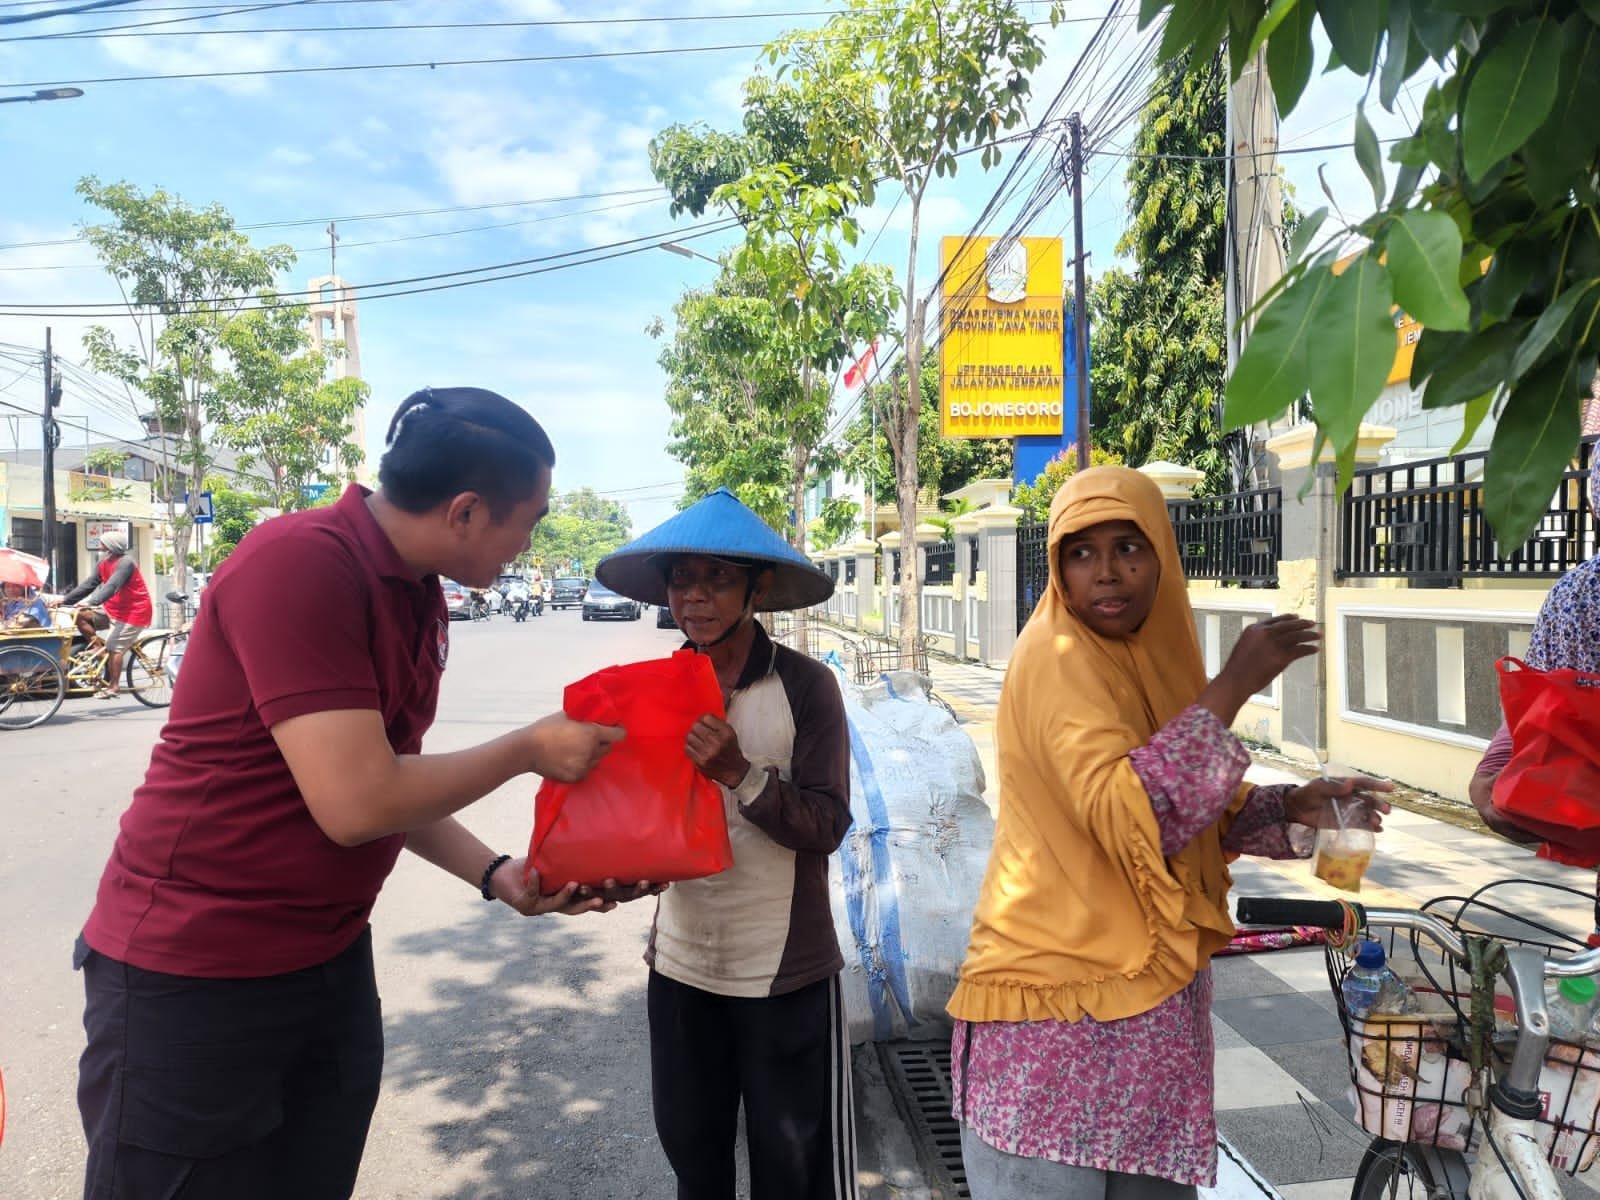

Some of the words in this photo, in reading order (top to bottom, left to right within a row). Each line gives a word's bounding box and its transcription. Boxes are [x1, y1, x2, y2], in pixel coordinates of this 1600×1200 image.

[999, 320, 1026, 332] JAWA
[1028, 320, 1060, 332] TIMUR
[951, 376, 984, 389] JALAN
[986, 376, 1007, 389] DAN
[1008, 376, 1061, 389] JEMBATAN
[950, 401, 1062, 417] BOJONEGORO
